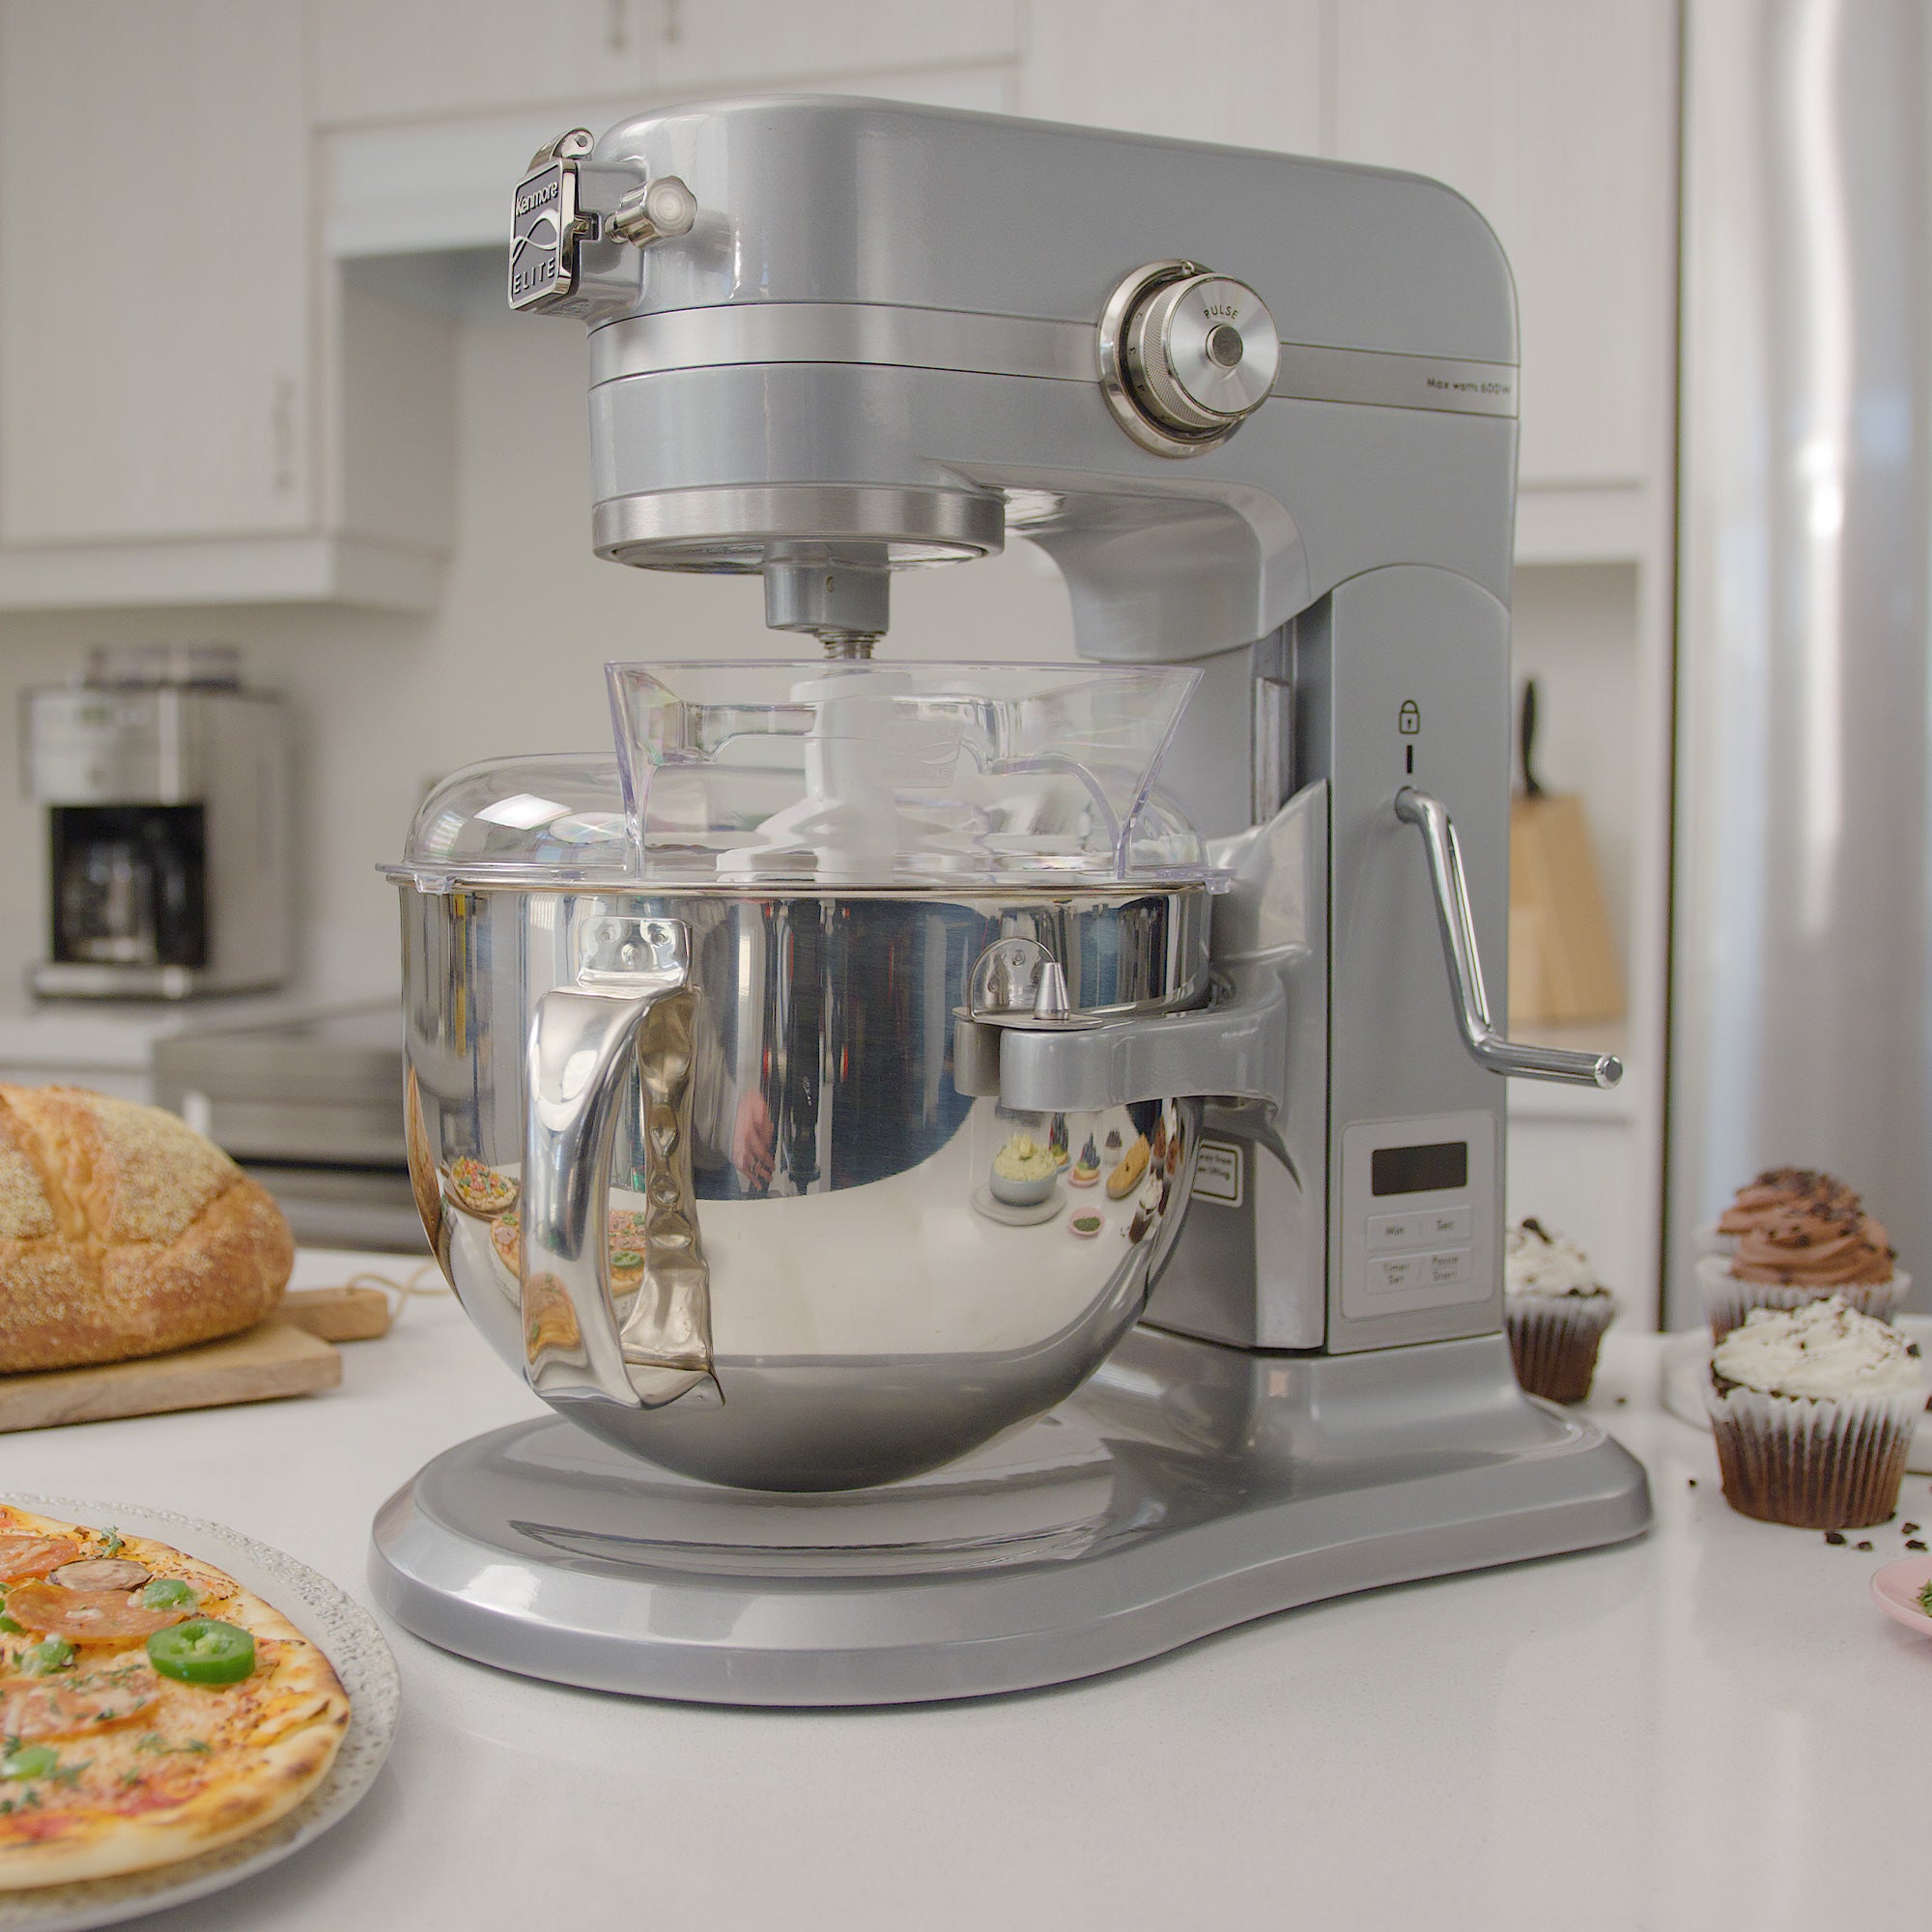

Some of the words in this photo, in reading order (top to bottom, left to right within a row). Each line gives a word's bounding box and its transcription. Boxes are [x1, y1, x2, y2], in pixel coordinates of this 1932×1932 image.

[516, 181, 557, 217] Kenmore
[513, 257, 555, 294] ELITE
[1204, 305, 1239, 320] PULSE
[1427, 378, 1449, 389] Max
